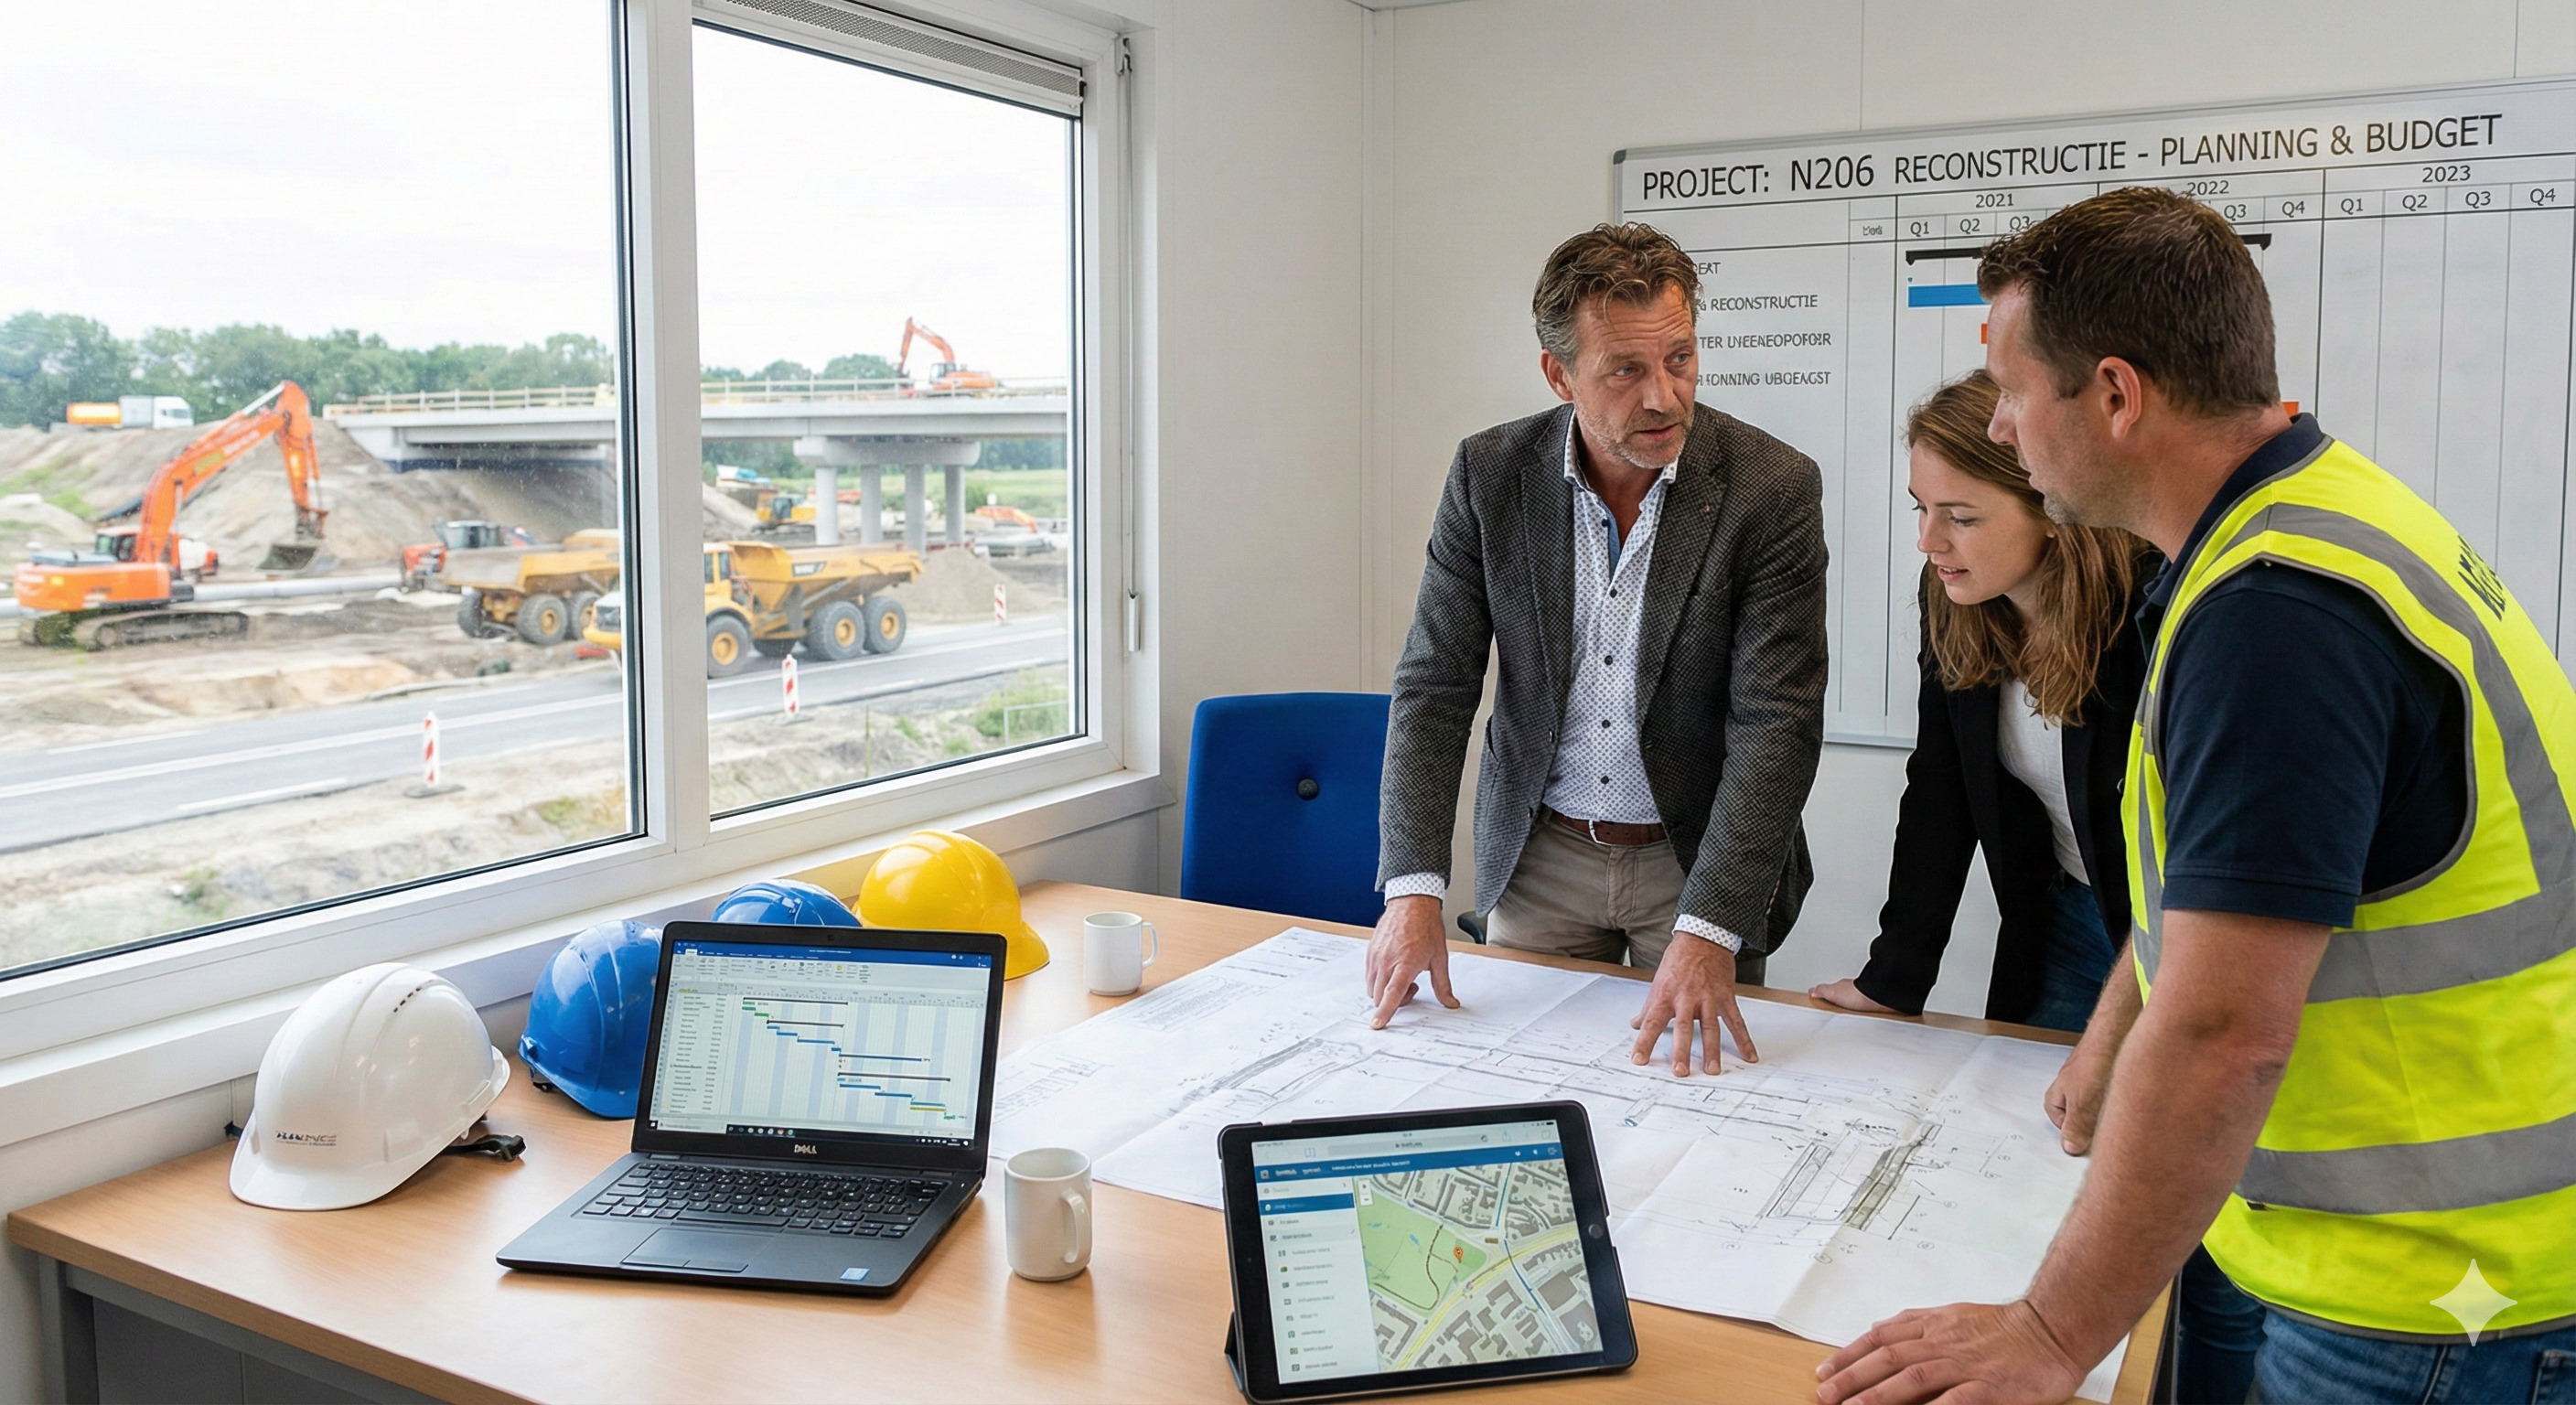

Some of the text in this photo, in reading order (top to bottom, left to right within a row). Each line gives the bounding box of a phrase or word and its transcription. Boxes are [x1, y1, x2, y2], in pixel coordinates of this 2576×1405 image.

[1643, 164, 1769, 200] PROJECT:
[1790, 154, 1874, 191] N206
[1894, 141, 2127, 184] RECONSTRUCTIE
[2161, 127, 2318, 166] PLANNING
[2330, 124, 2355, 156] &
[2366, 113, 2503, 154] BUDGET
[2421, 165, 2472, 183] 2023
[2186, 180, 2229, 197] 2022
[1975, 193, 2014, 209] 2021
[2224, 200, 2305, 221] Q3 Q4
[2340, 188, 2556, 215] Q1 Q2 Q3 Q4
[1910, 216, 2030, 237] Q1 Q2 Q3
[1711, 295, 1819, 311] RECONSTRUCTIE
